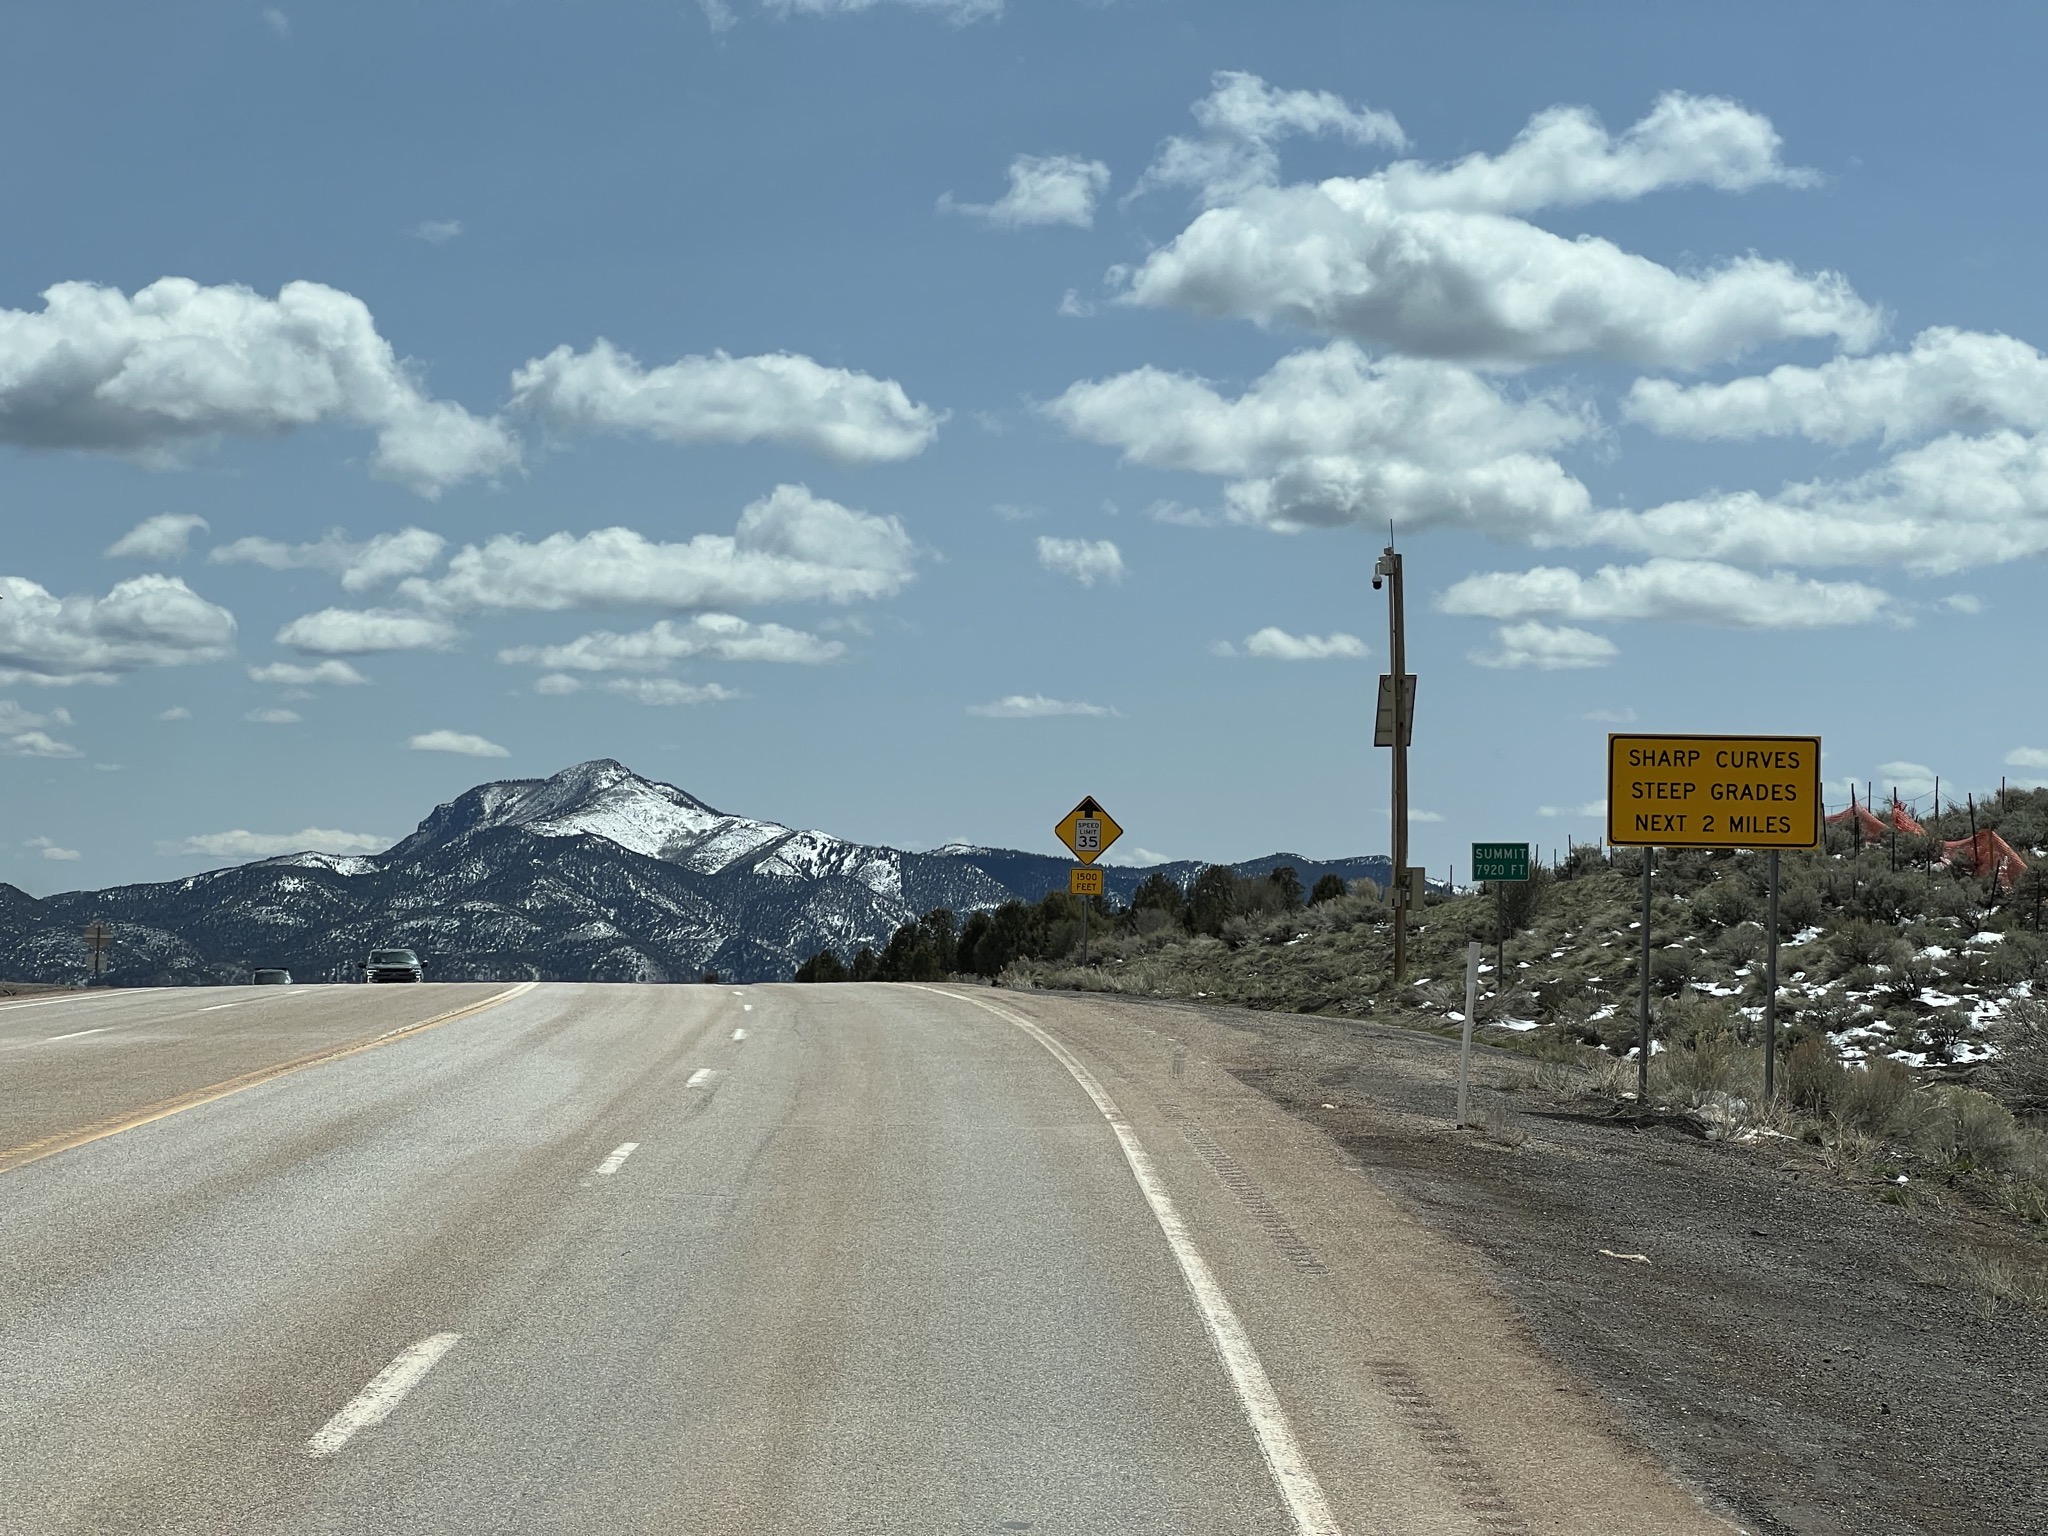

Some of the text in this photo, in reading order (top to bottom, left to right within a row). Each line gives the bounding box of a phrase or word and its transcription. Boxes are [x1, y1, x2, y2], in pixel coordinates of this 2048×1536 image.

[1629, 749, 1800, 769] SHARP CURVES
[1631, 782, 1797, 801] STEEP GRADES
[1635, 814, 1791, 834] NEXT 2 MILES
[1078, 836, 1098, 848] 35
[1475, 848, 1526, 859] SUMMIT
[1077, 872, 1097, 880] 1500
[1476, 864, 1505, 876] 7920
[1076, 883, 1096, 891] FEET
